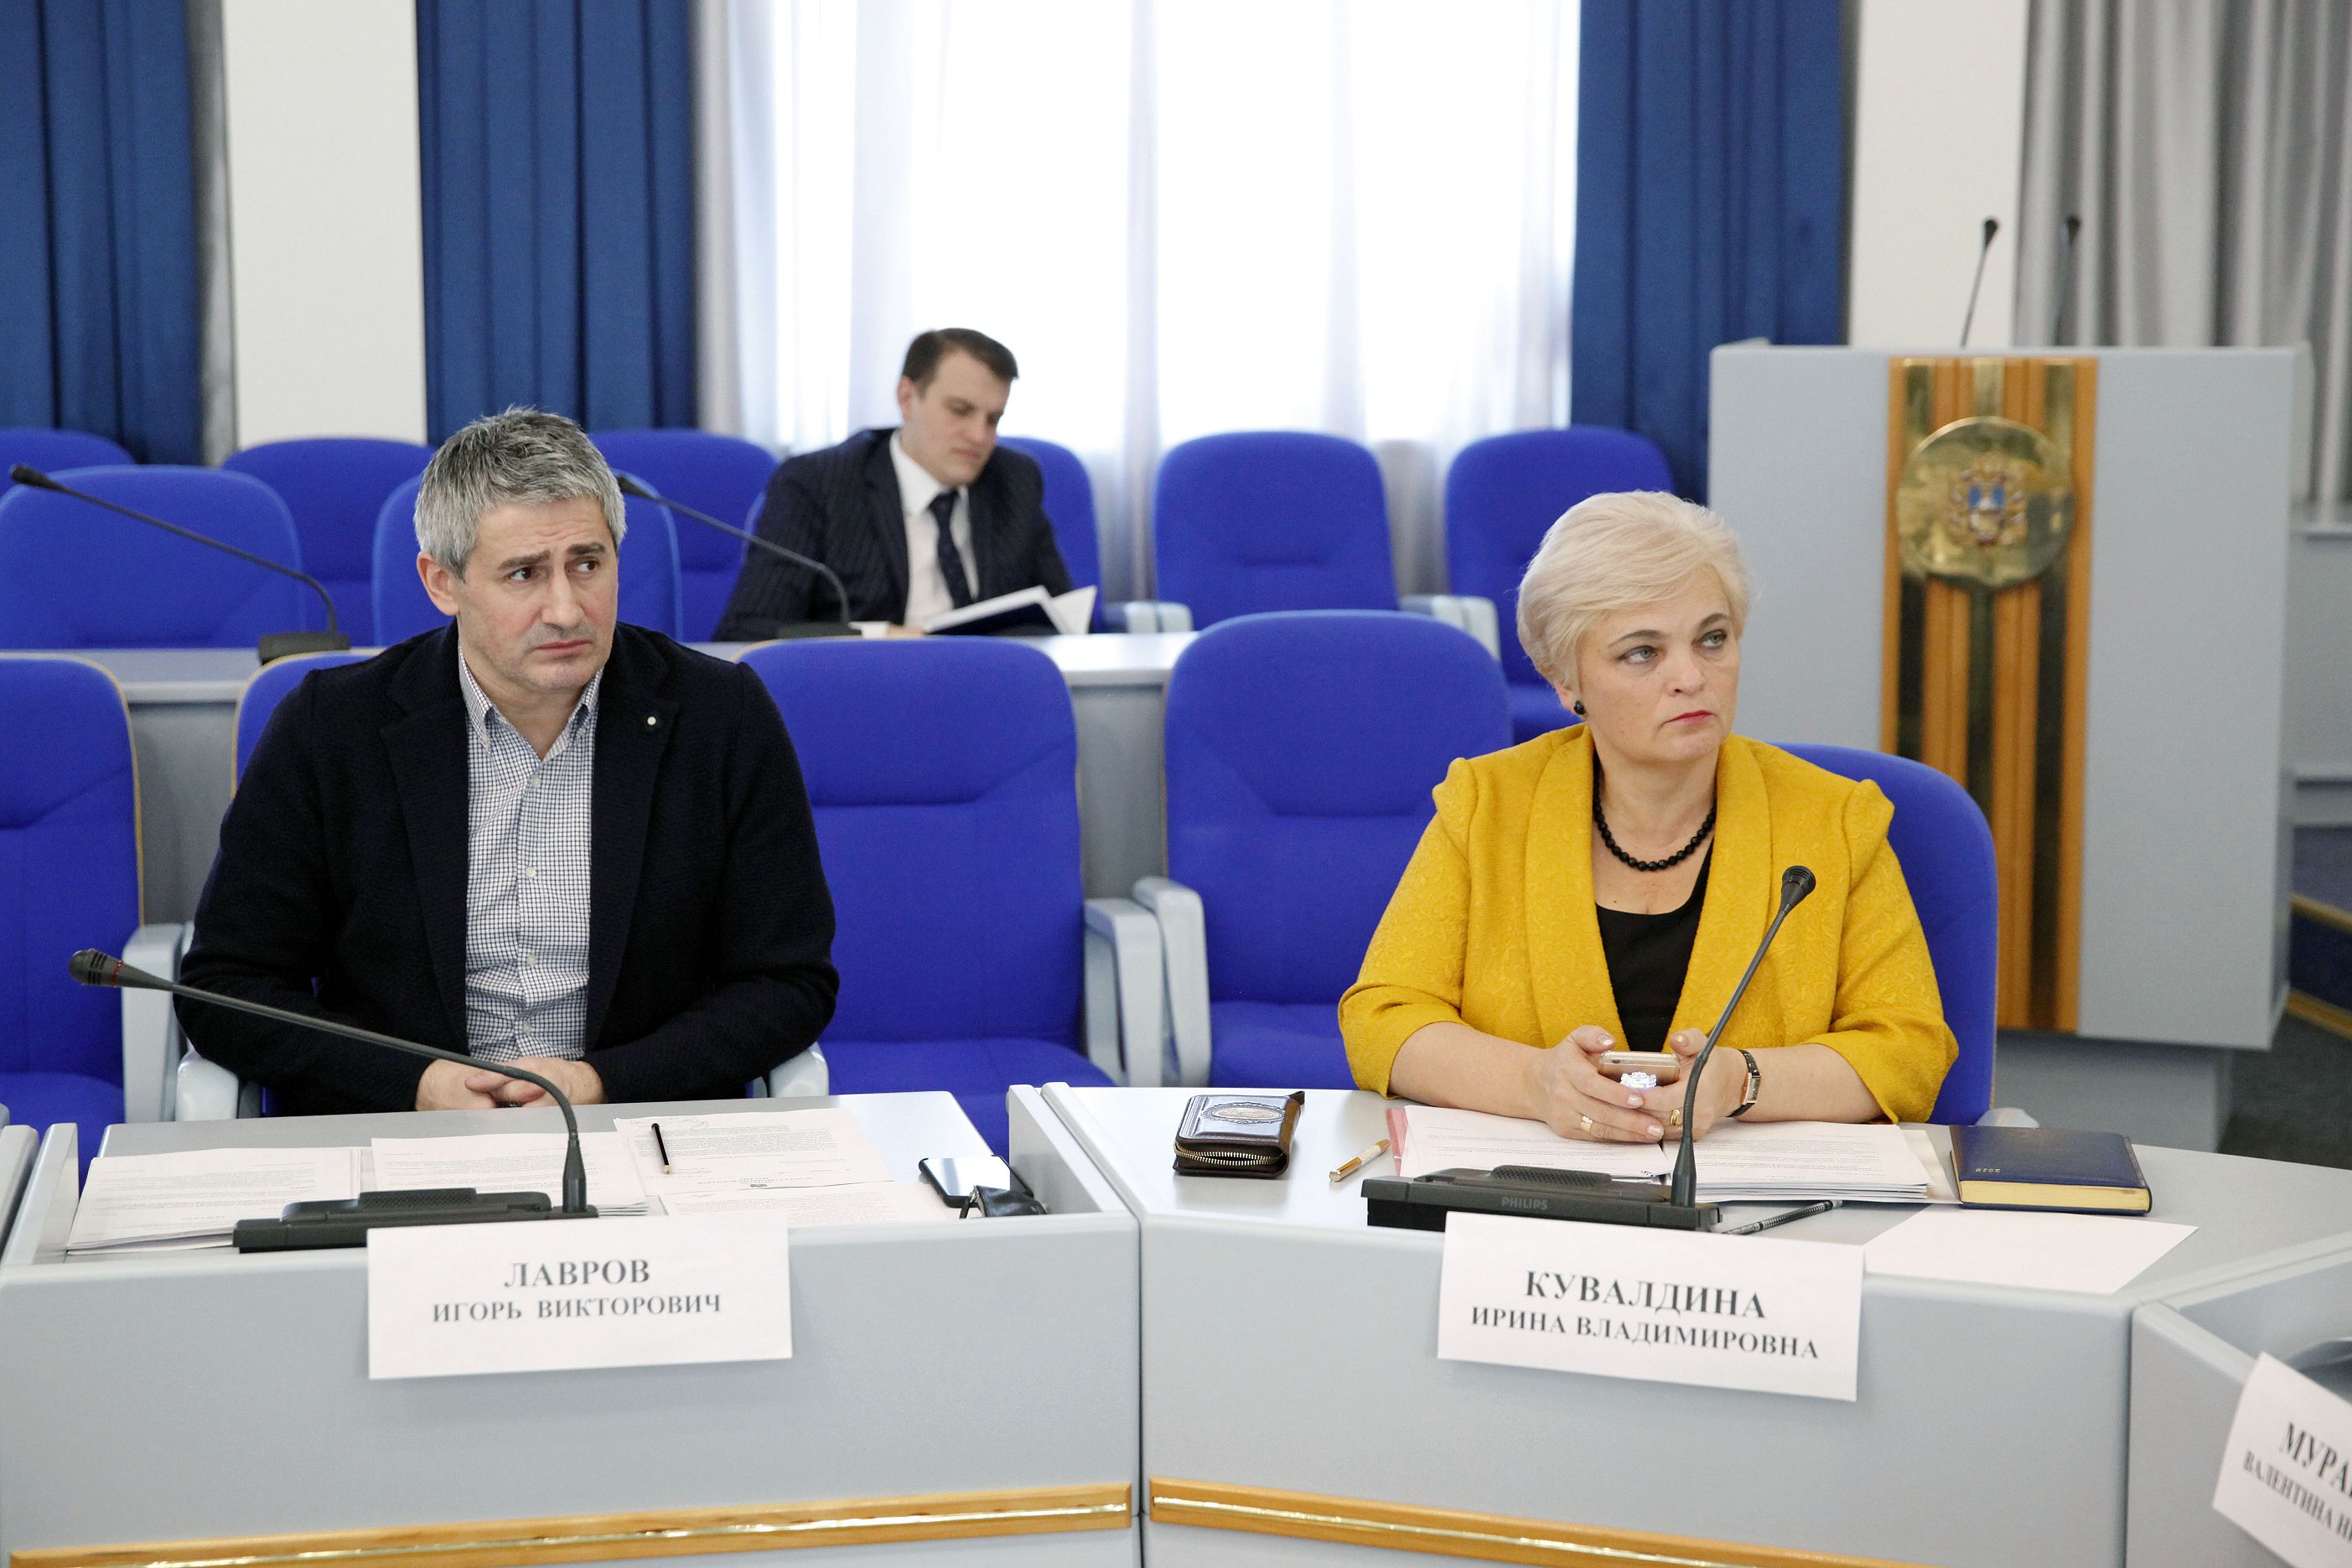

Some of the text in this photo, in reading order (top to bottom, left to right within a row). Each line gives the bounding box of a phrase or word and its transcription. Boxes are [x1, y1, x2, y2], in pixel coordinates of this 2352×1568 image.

[1500, 1195, 1549, 1210] PHILIPS
[503, 1259, 650, 1288] ЛАВРОВ
[433, 1294, 722, 1323] ИГОРЬ ВИКТОРОВИЧ
[1524, 1270, 1767, 1319] КУВАЛДИНА
[1471, 1305, 1820, 1359] ИРИНА ВЛАДИМИРОВНА
[2242, 1449, 2333, 1529] ВАЛЕНТИНА
